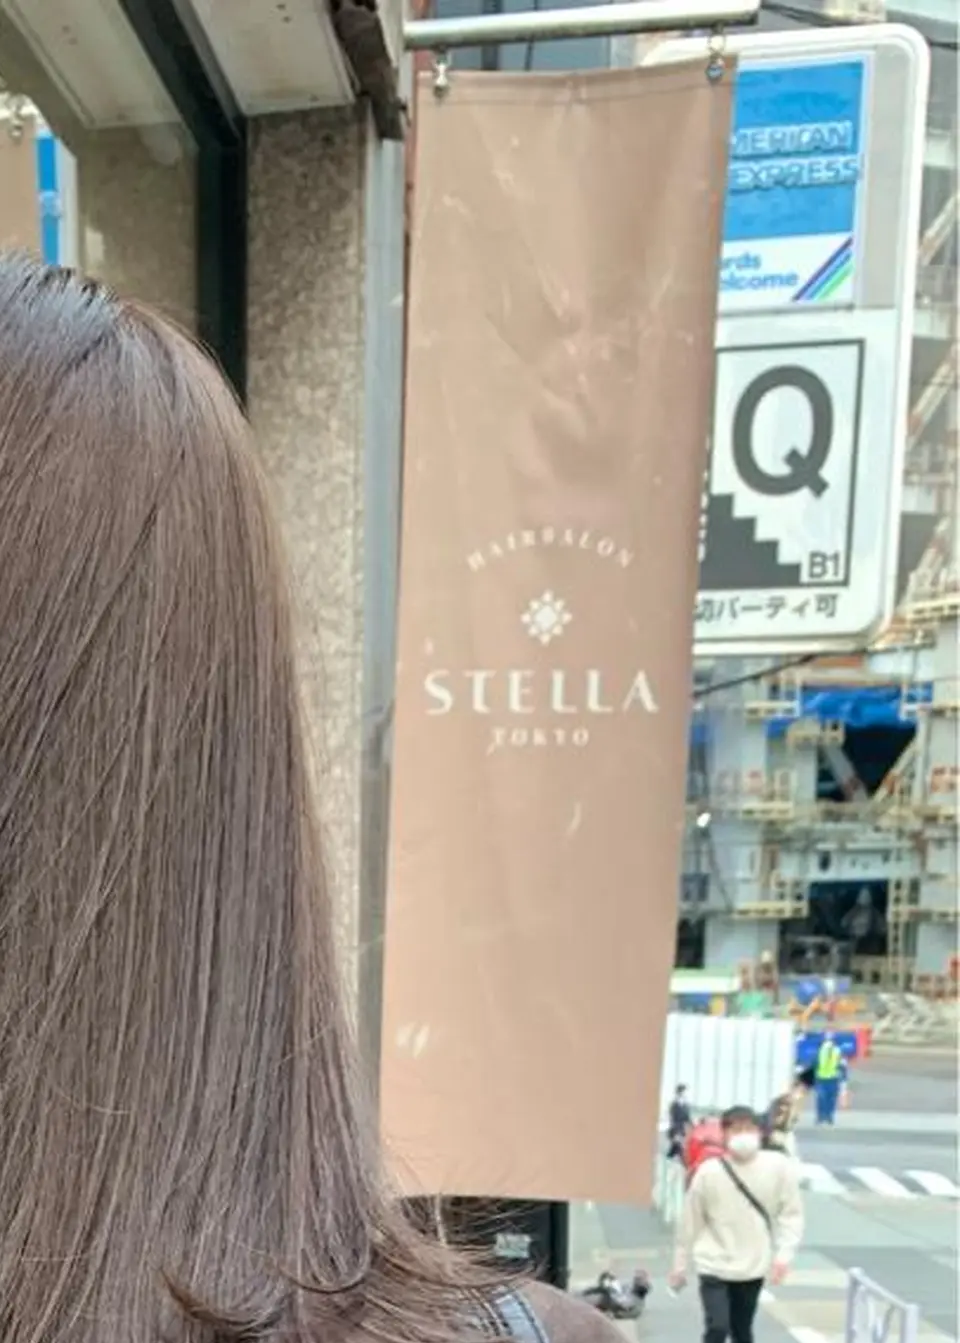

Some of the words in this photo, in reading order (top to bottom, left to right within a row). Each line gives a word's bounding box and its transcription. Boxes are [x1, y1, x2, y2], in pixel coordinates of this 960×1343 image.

[731, 156, 864, 190] EXPRESS
[732, 364, 834, 498] Q
[809, 551, 840, 579] B1
[424, 668, 659, 714] STELLA
[493, 726, 589, 747] TOKYO
